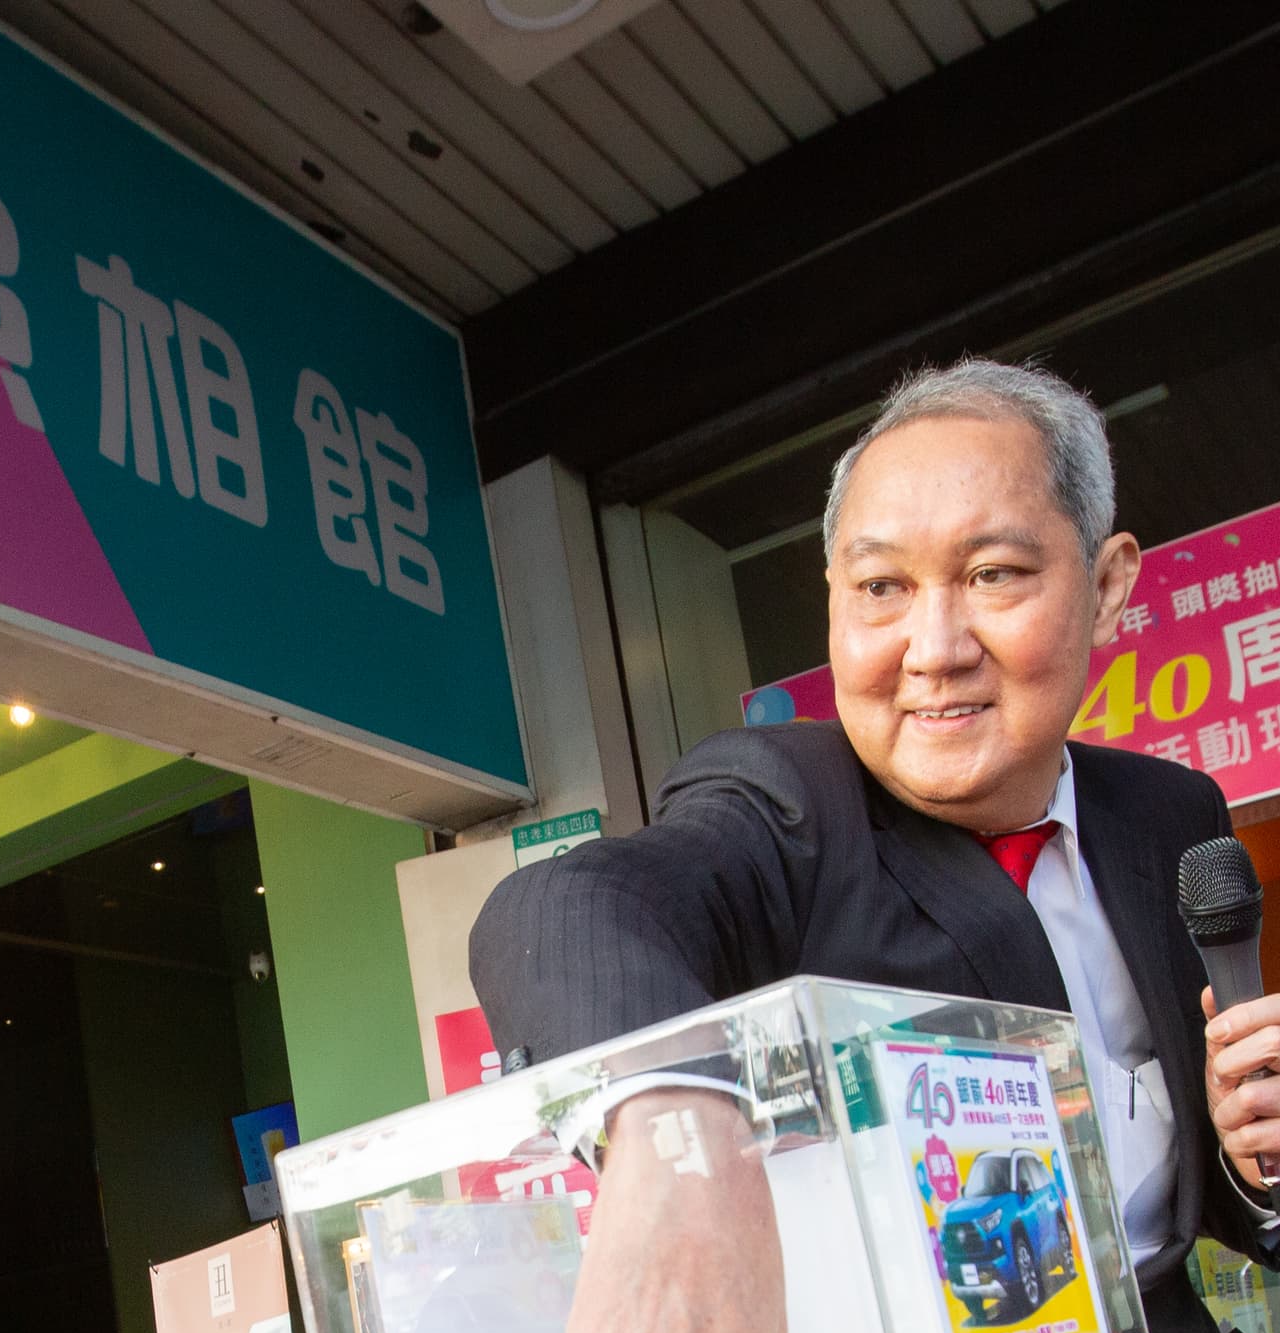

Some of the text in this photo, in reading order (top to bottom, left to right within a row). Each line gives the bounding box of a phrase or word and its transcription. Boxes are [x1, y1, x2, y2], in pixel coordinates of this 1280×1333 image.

[518, 813, 596, 846] 忠孝東路四段
